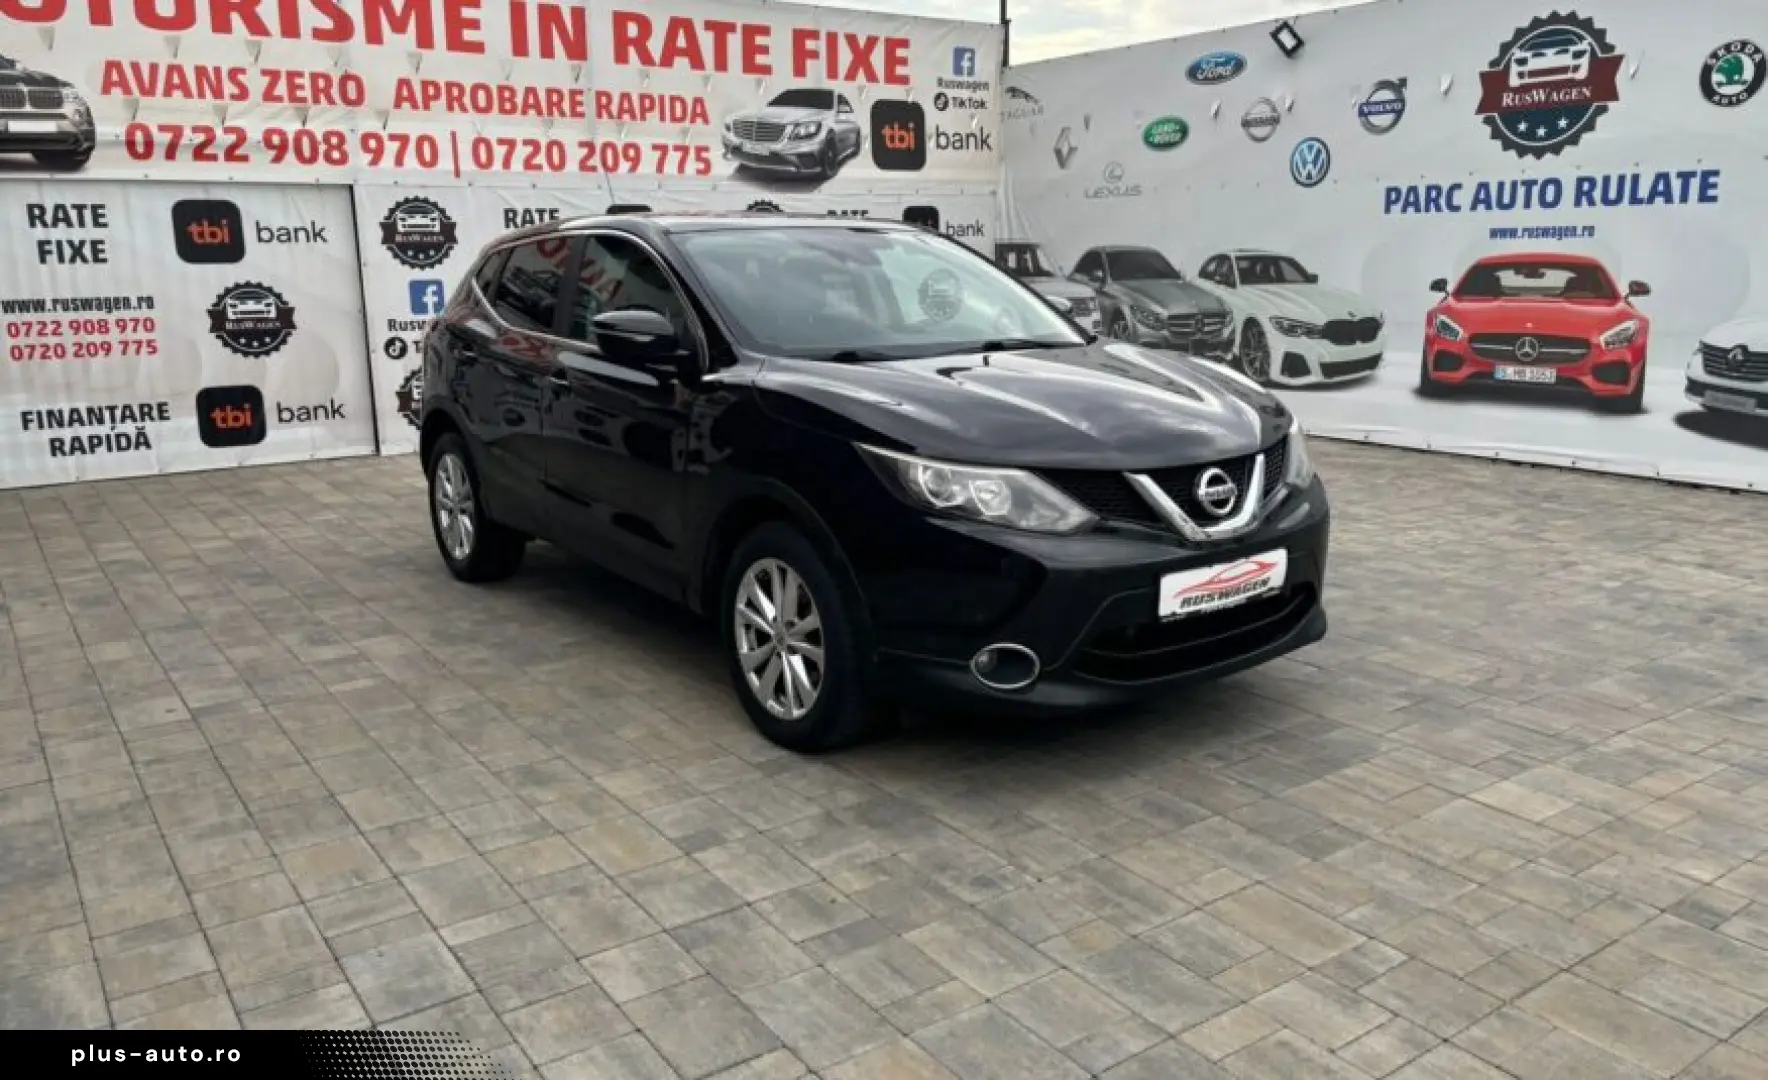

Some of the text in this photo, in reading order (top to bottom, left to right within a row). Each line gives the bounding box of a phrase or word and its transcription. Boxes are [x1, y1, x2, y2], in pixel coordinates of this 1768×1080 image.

[509, 0, 588, 62] IN
[612, 9, 774, 76] RATE
[792, 27, 911, 86] FIXE
[101, 60, 710, 126] AVANS ZERO APROBARE RAPIDA
[952, 96, 987, 109] TikTok
[125, 122, 250, 163] 0722
[262, 128, 350, 166] 908
[360, 132, 439, 169] 970
[472, 136, 566, 171] 0720
[577, 140, 643, 174] 209
[651, 143, 712, 176] 775
[882, 121, 993, 152] tbi bank
[1084, 184, 1142, 199] LEXUS
[1384, 169, 1721, 215] PARC AUTO RULATE
[27, 203, 109, 229] RATE
[946, 219, 985, 237] bank
[187, 220, 328, 245] tbi bank
[1489, 225, 1596, 241] www.ruswagen.ro
[38, 238, 108, 265] FIXE
[1, 296, 155, 314] www.ruswagen.ro
[7, 316, 156, 338] 0722 908 970
[10, 338, 158, 361] 0720 209 775
[211, 398, 346, 429] tbi bank
[49, 427, 152, 457] RAPIDĂ
